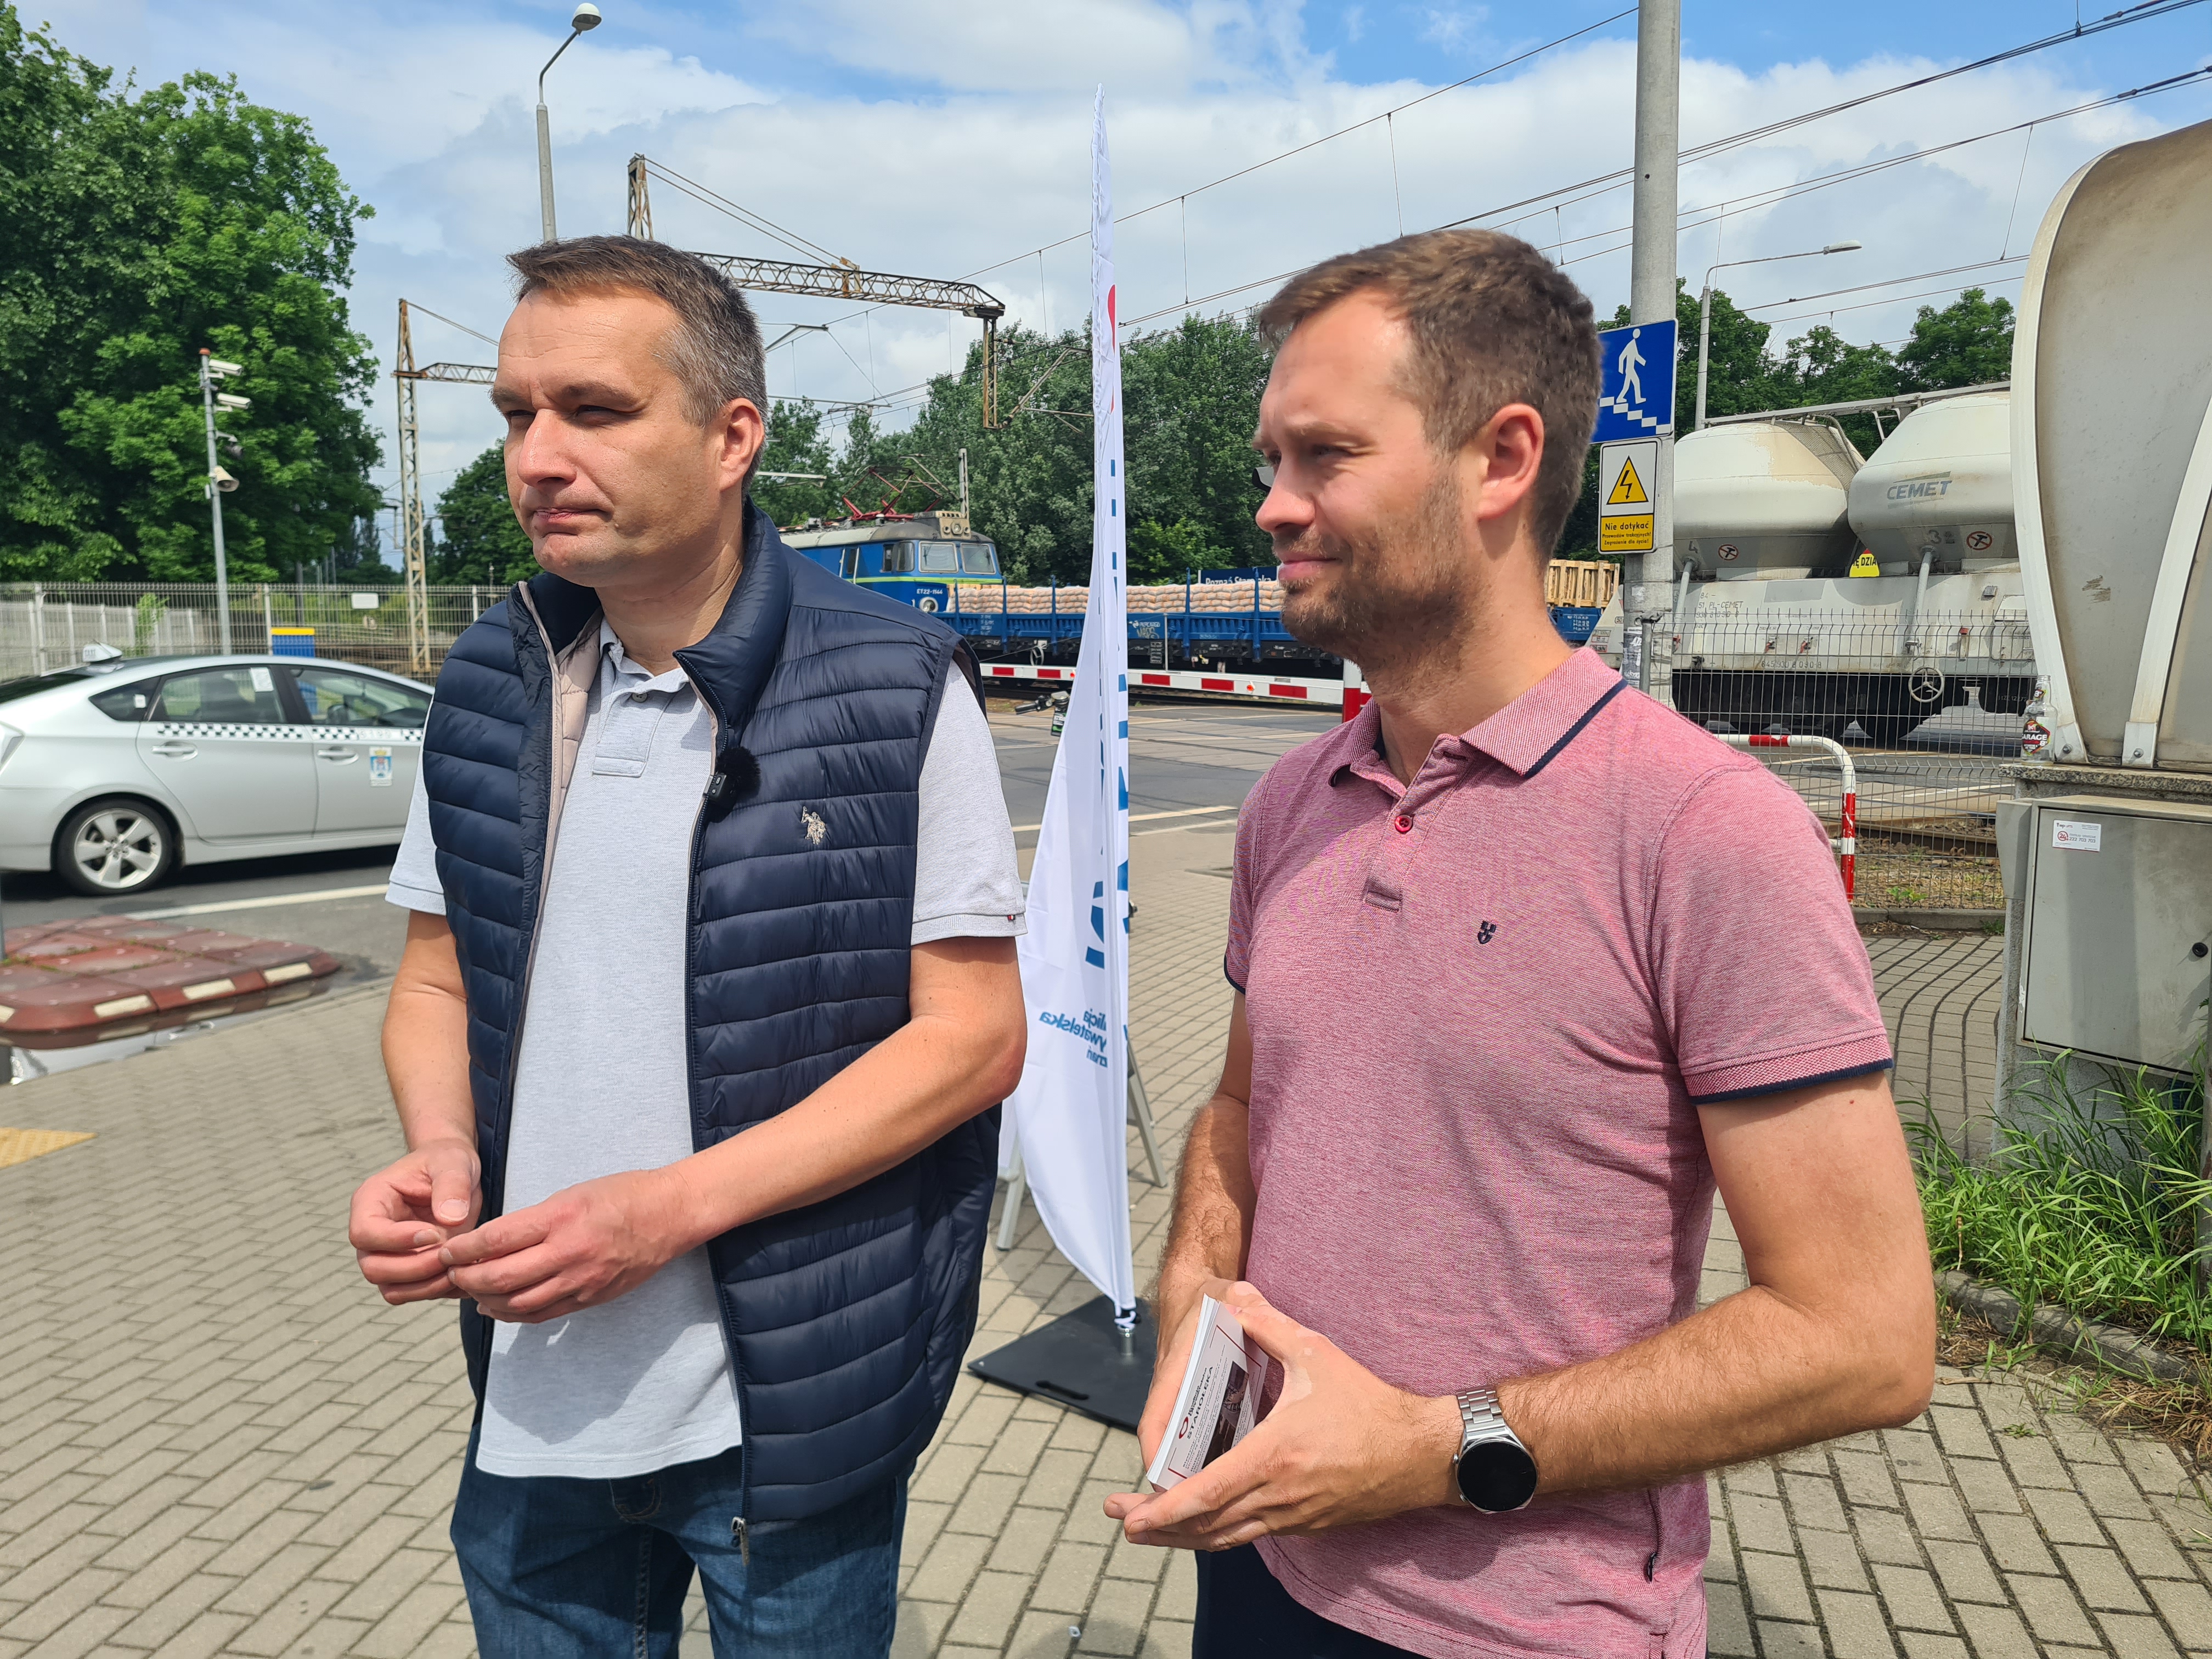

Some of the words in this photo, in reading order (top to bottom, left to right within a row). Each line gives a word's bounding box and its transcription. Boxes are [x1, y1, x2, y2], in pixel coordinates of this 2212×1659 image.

[1887, 480, 1952, 500] CEMET
[1620, 521, 1649, 531] dotykać
[1861, 557, 1877, 566] DZIA
